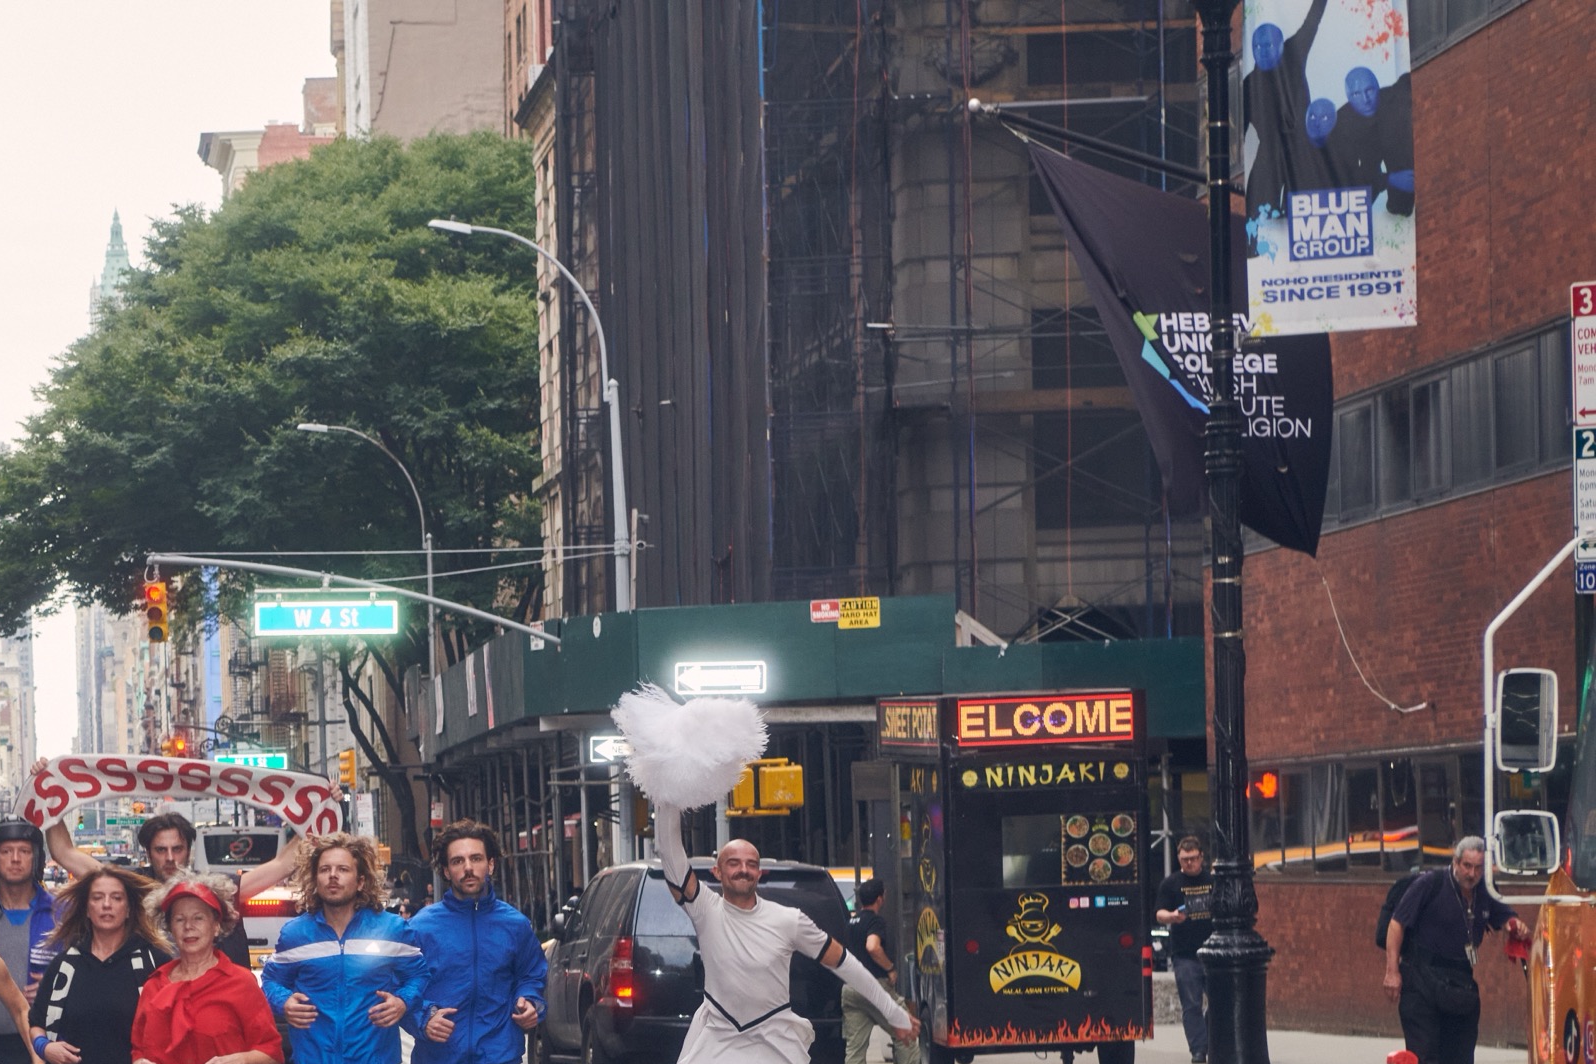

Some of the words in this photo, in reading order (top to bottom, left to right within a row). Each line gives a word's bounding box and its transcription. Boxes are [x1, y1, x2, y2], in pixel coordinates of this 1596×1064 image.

[1291, 190, 1367, 217] BLUE
[1292, 212, 1369, 242] MAN
[1292, 237, 1370, 259] GROUP
[1261, 276, 1309, 287] NOHO
[1262, 285, 1340, 304] SINCE
[1347, 280, 1403, 297] 1991
[1579, 287, 1593, 315] 3
[1581, 430, 1596, 458] 2
[293, 608, 312, 628] W
[319, 608, 333, 628] 4
[339, 607, 360, 628] St
[820, 603, 831, 611] NO
[960, 698, 1132, 739] ELCOME
[984, 761, 1106, 789] NINJAKI
[992, 953, 1077, 983] NINJAKI
